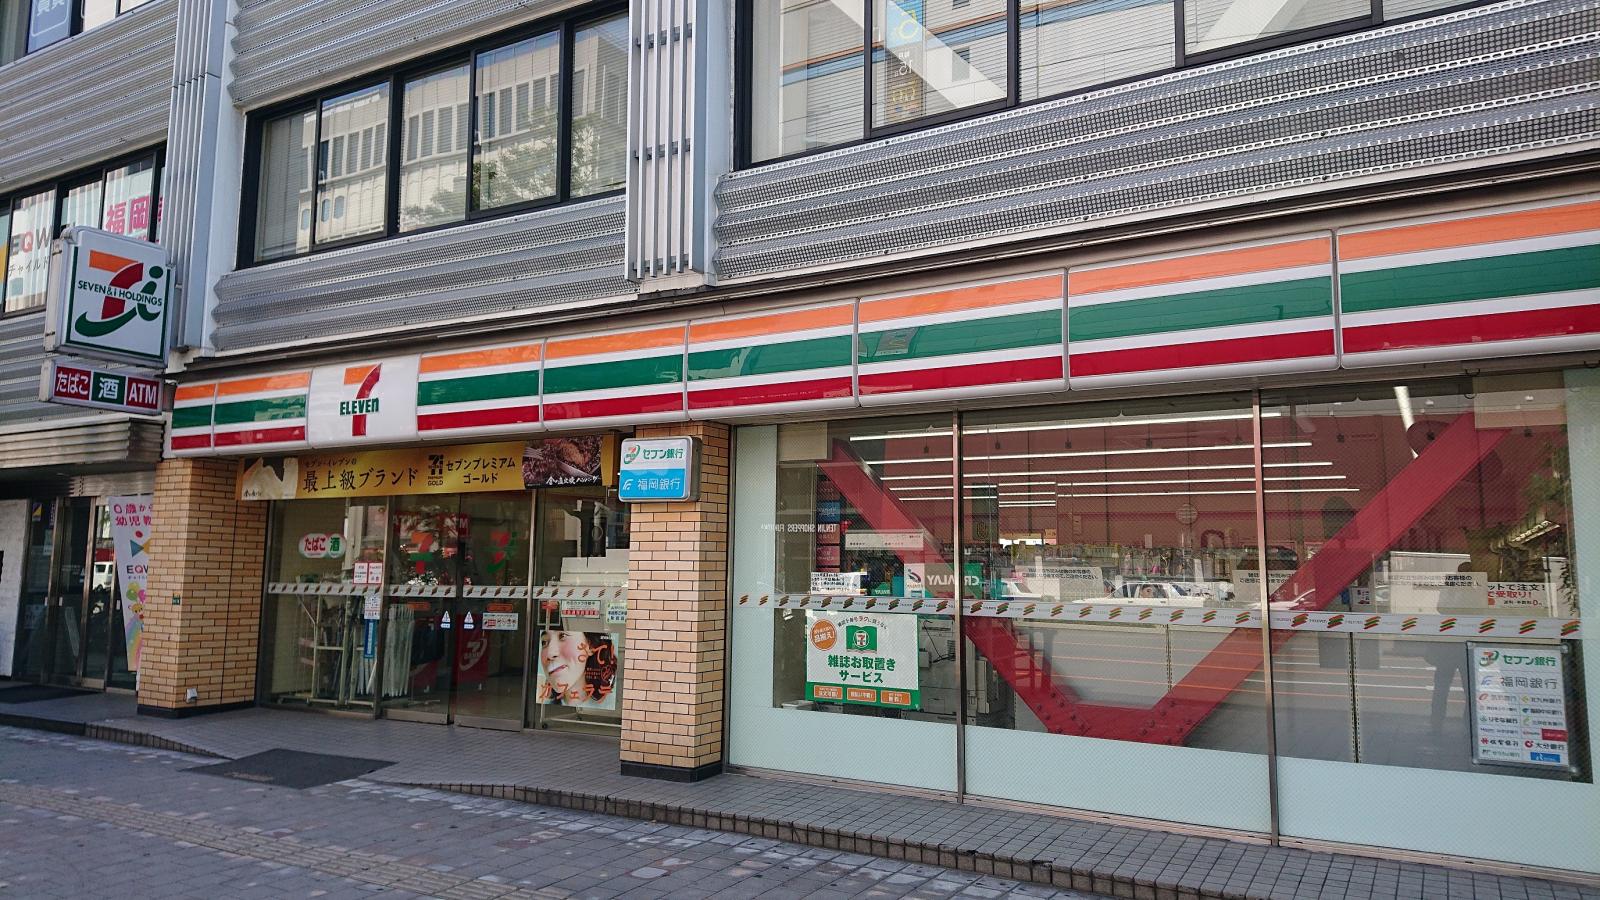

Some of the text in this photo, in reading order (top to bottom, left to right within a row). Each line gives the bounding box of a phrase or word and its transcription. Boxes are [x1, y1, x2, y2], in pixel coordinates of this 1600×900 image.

[118, 290, 162, 306] HOLDINGS
[56, 371, 89, 395] たばこ
[98, 377, 120, 400] 酒
[129, 382, 157, 405] ATM
[643, 448, 684, 460] セブン銀行
[446, 457, 516, 472] セブンプレミアム
[303, 468, 418, 492] 最上級ブランド
[463, 473, 499, 485] ゴールド
[638, 478, 681, 491] 福岡銀行
[304, 537, 326, 552] たばこ
[330, 537, 340, 552] 酒
[828, 654, 896, 672] 雑誌お取置き
[1504, 654, 1557, 667] セブン銀行
[839, 670, 884, 684] サービス
[1501, 676, 1558, 690] 福岡銀行
